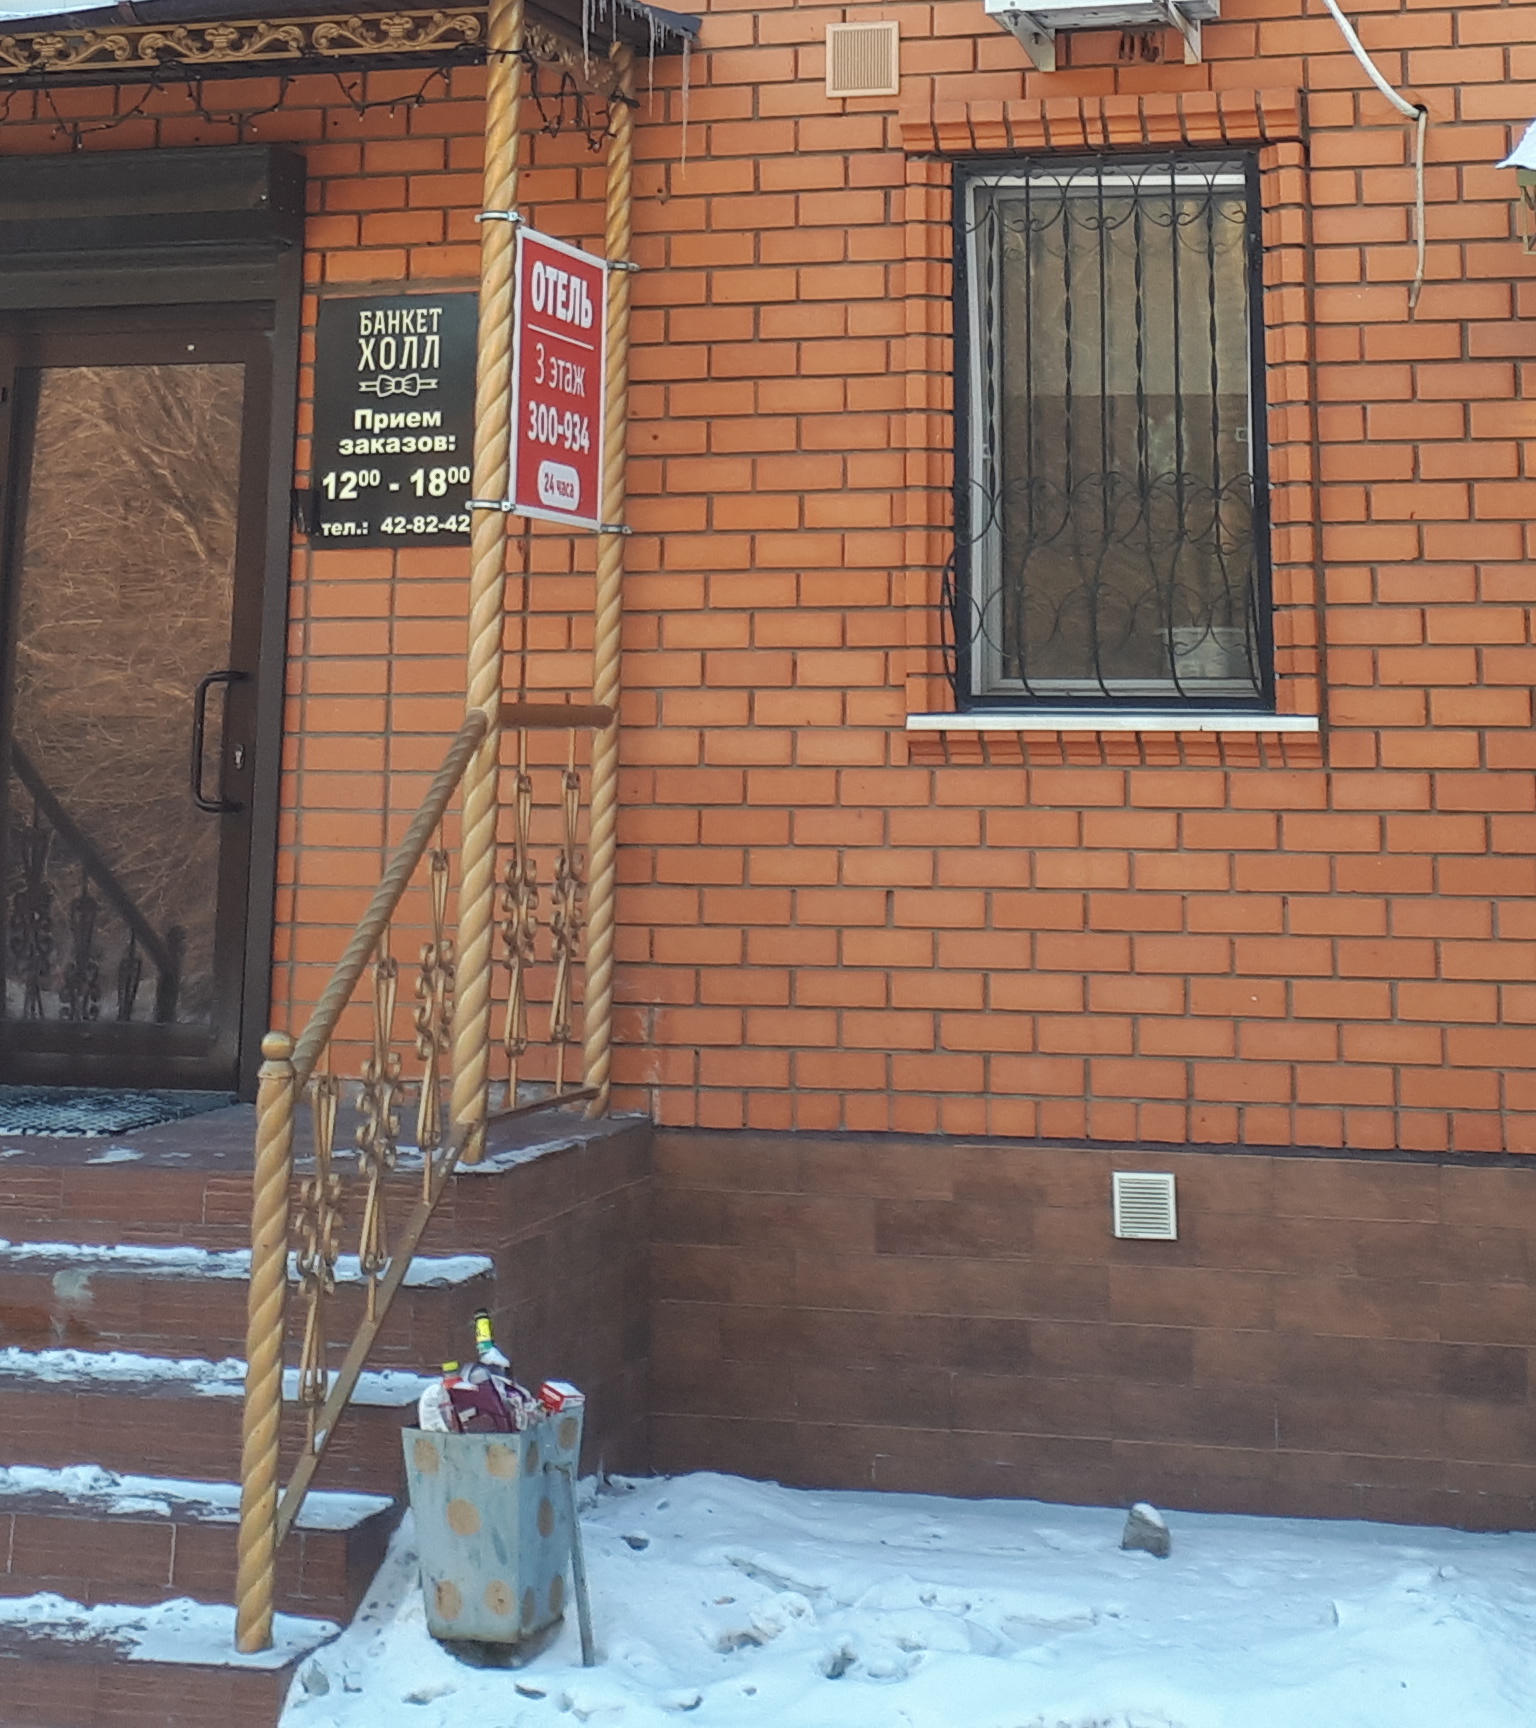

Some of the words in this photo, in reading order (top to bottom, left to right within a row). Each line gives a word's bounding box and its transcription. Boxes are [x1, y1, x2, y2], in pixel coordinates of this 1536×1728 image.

[531, 260, 593, 329] ОТЕЛЬ
[359, 307, 443, 336] БАНКЕТ
[357, 334, 440, 372] ХОЛЛ
[535, 342, 545, 385] 3
[548, 356, 586, 398] этаж
[353, 407, 442, 435] Прием
[527, 400, 590, 455] 300-934
[338, 434, 457, 456] заказов:
[543, 472, 555, 495] 24
[320, 521, 369, 537] тел.:
[379, 514, 471, 535] 42-82-42
